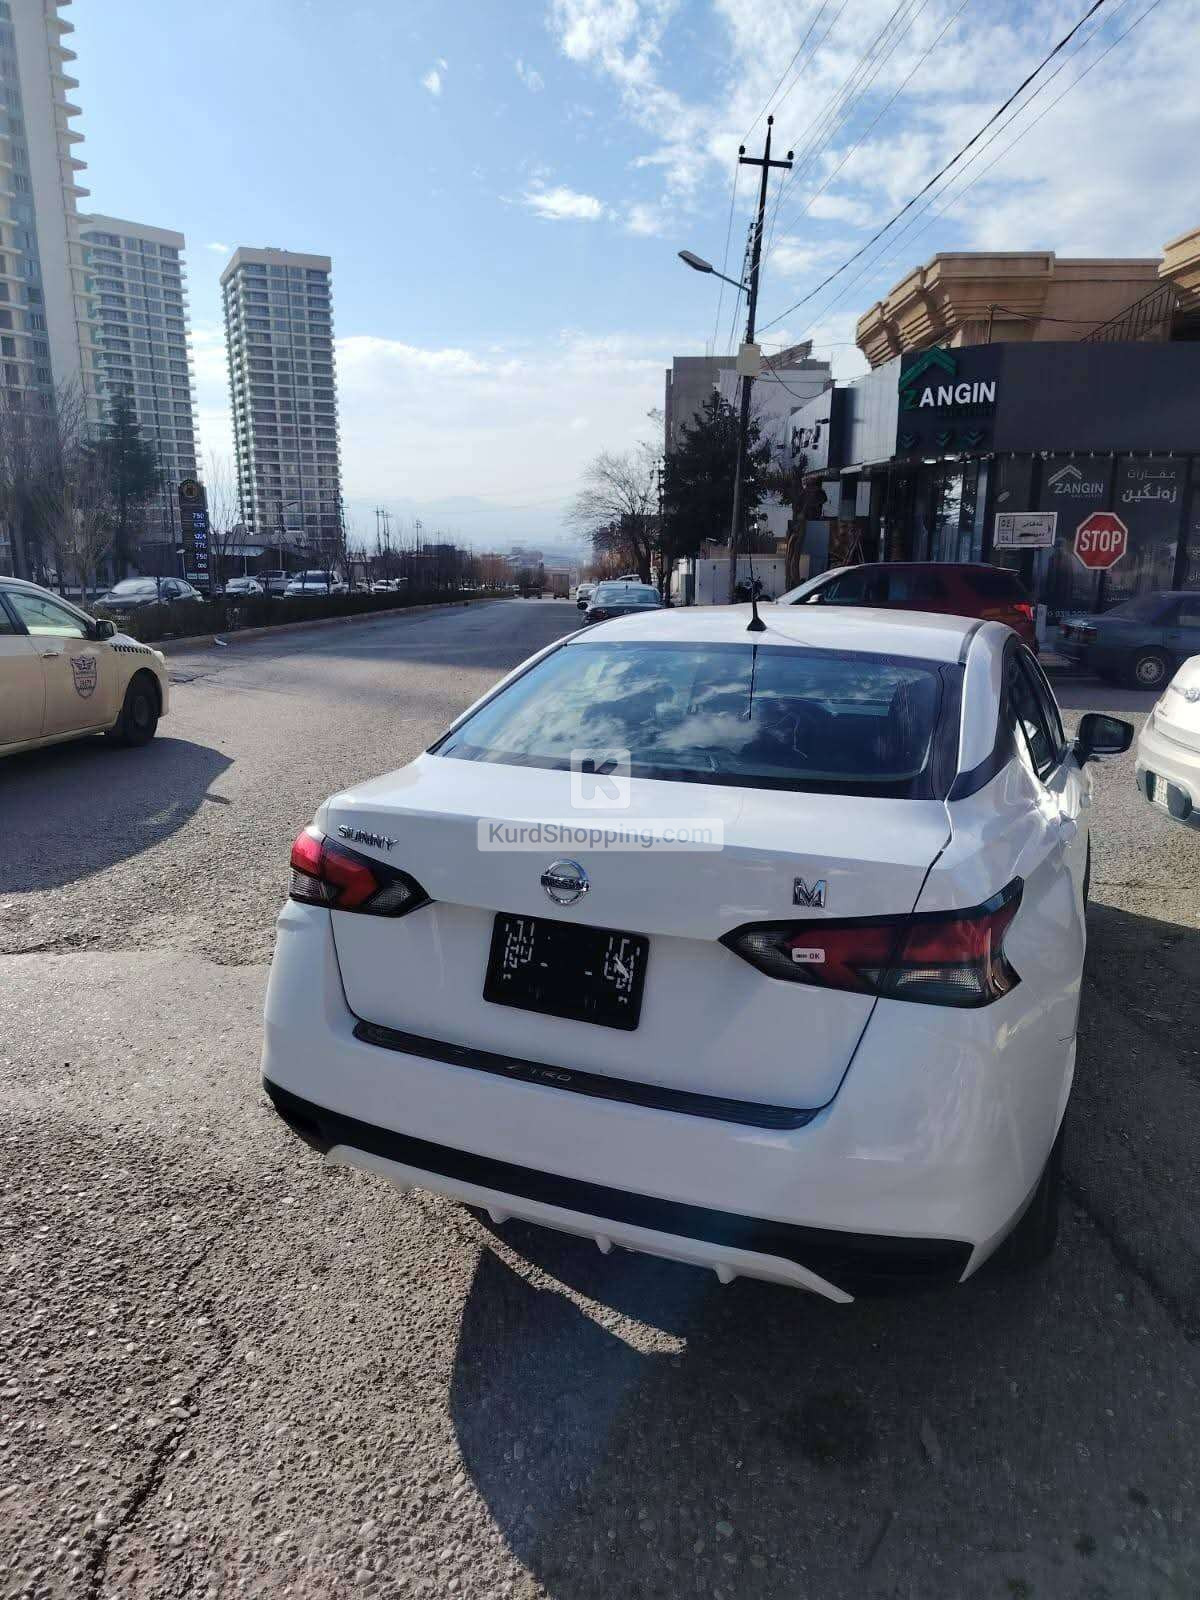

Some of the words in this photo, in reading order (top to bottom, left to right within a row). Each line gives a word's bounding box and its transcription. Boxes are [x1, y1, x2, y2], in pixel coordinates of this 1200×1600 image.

[903, 381, 997, 410] ZANGIN
[1054, 482, 1104, 494] ZANGIN
[1079, 530, 1122, 553] STOP
[337, 824, 400, 851] SUNNY
[808, 952, 821, 960] OK
